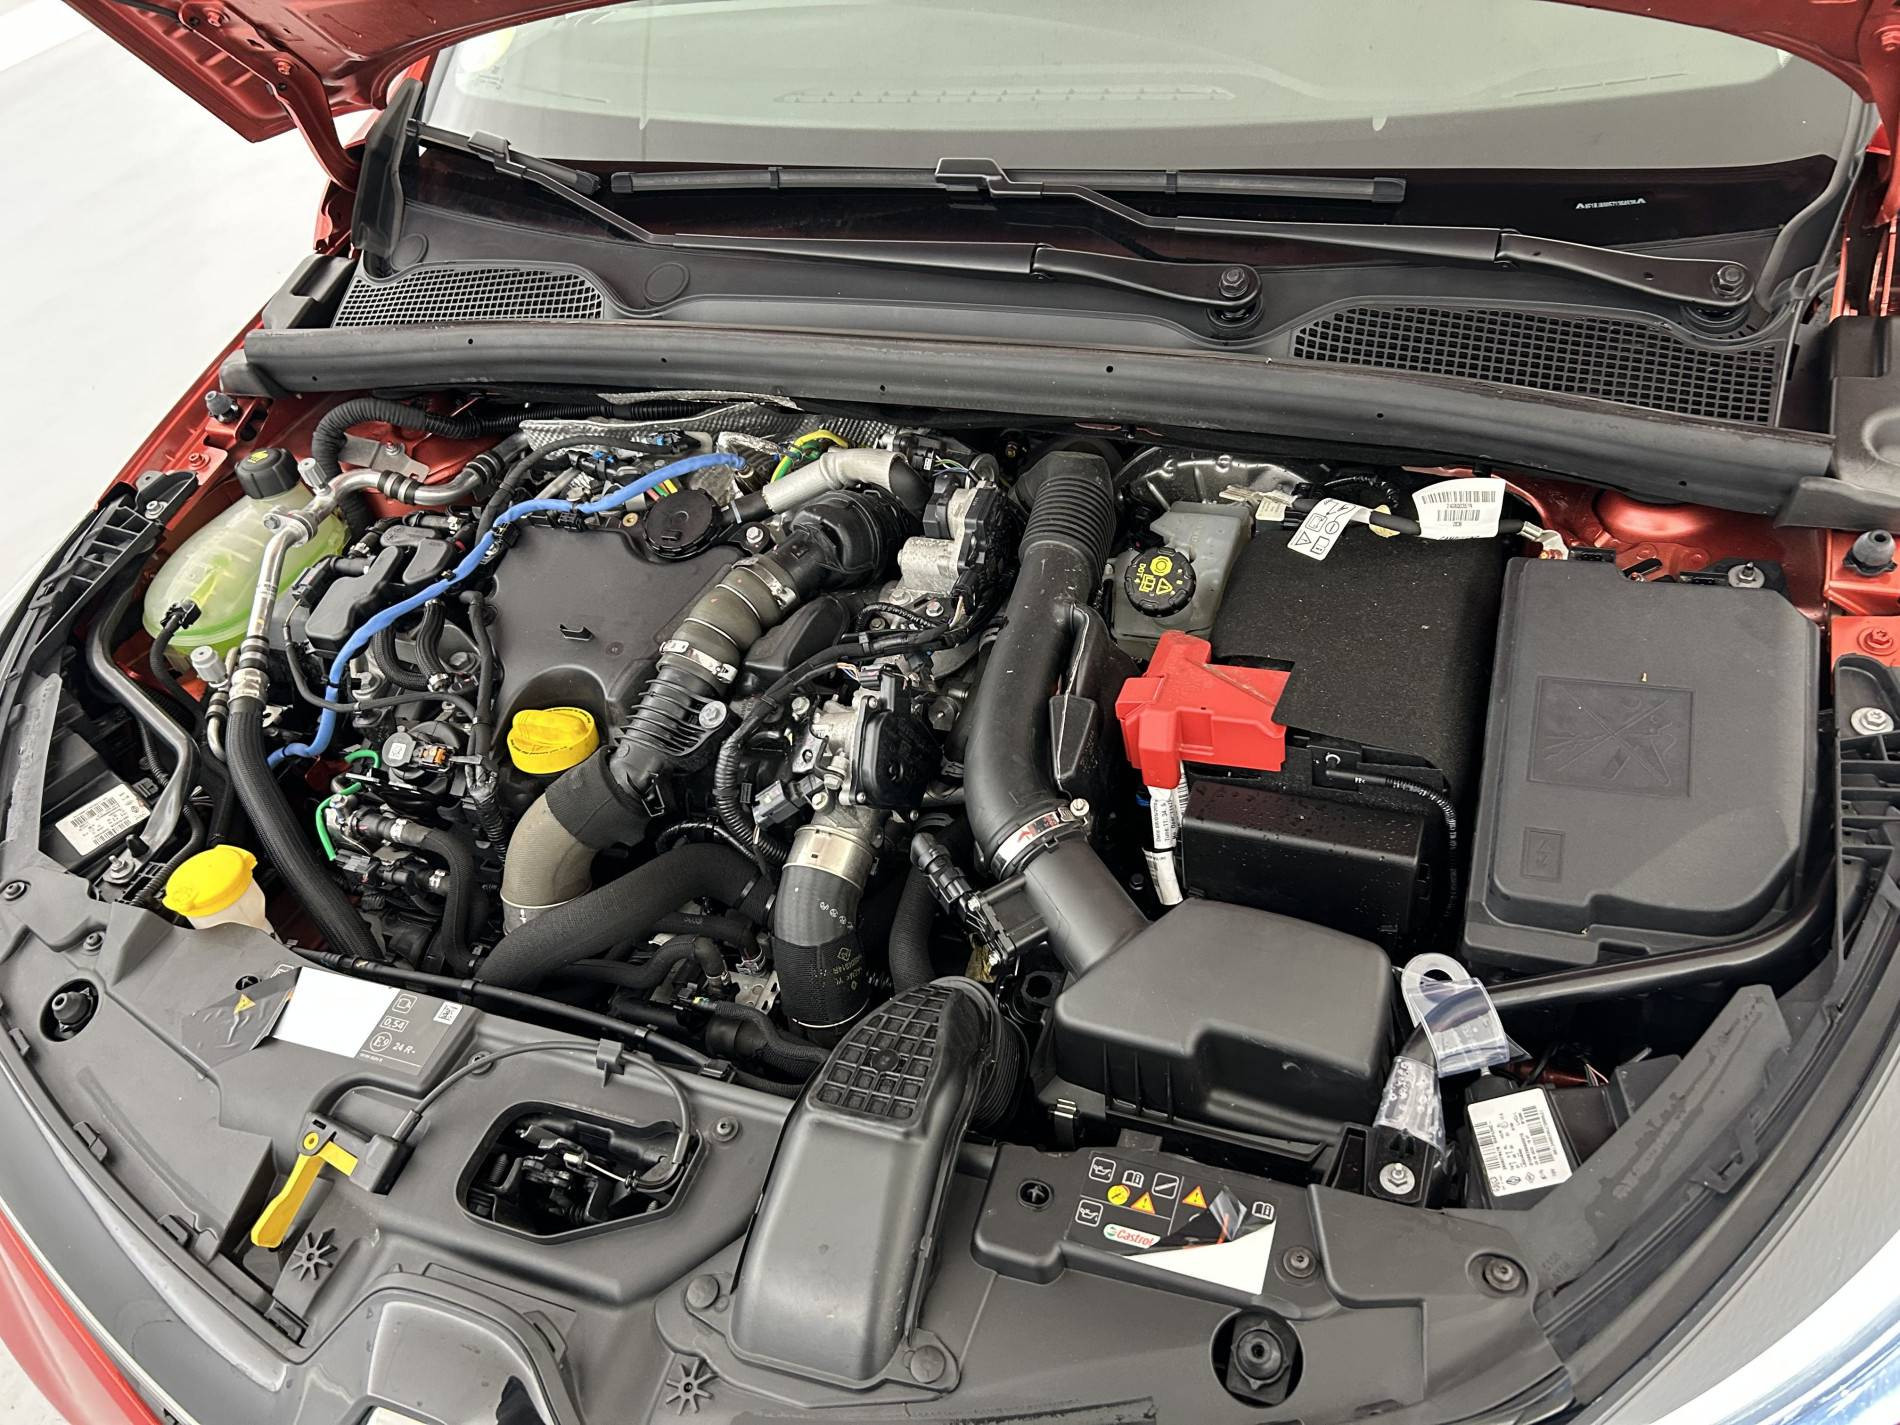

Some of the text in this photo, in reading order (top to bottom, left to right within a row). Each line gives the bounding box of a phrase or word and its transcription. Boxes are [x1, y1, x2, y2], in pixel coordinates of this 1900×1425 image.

[1137, 563, 1146, 577] DOT
[384, 1018, 405, 1029] 0.54
[392, 1042, 405, 1052] 24
[1117, 1229, 1153, 1245] Castrol
